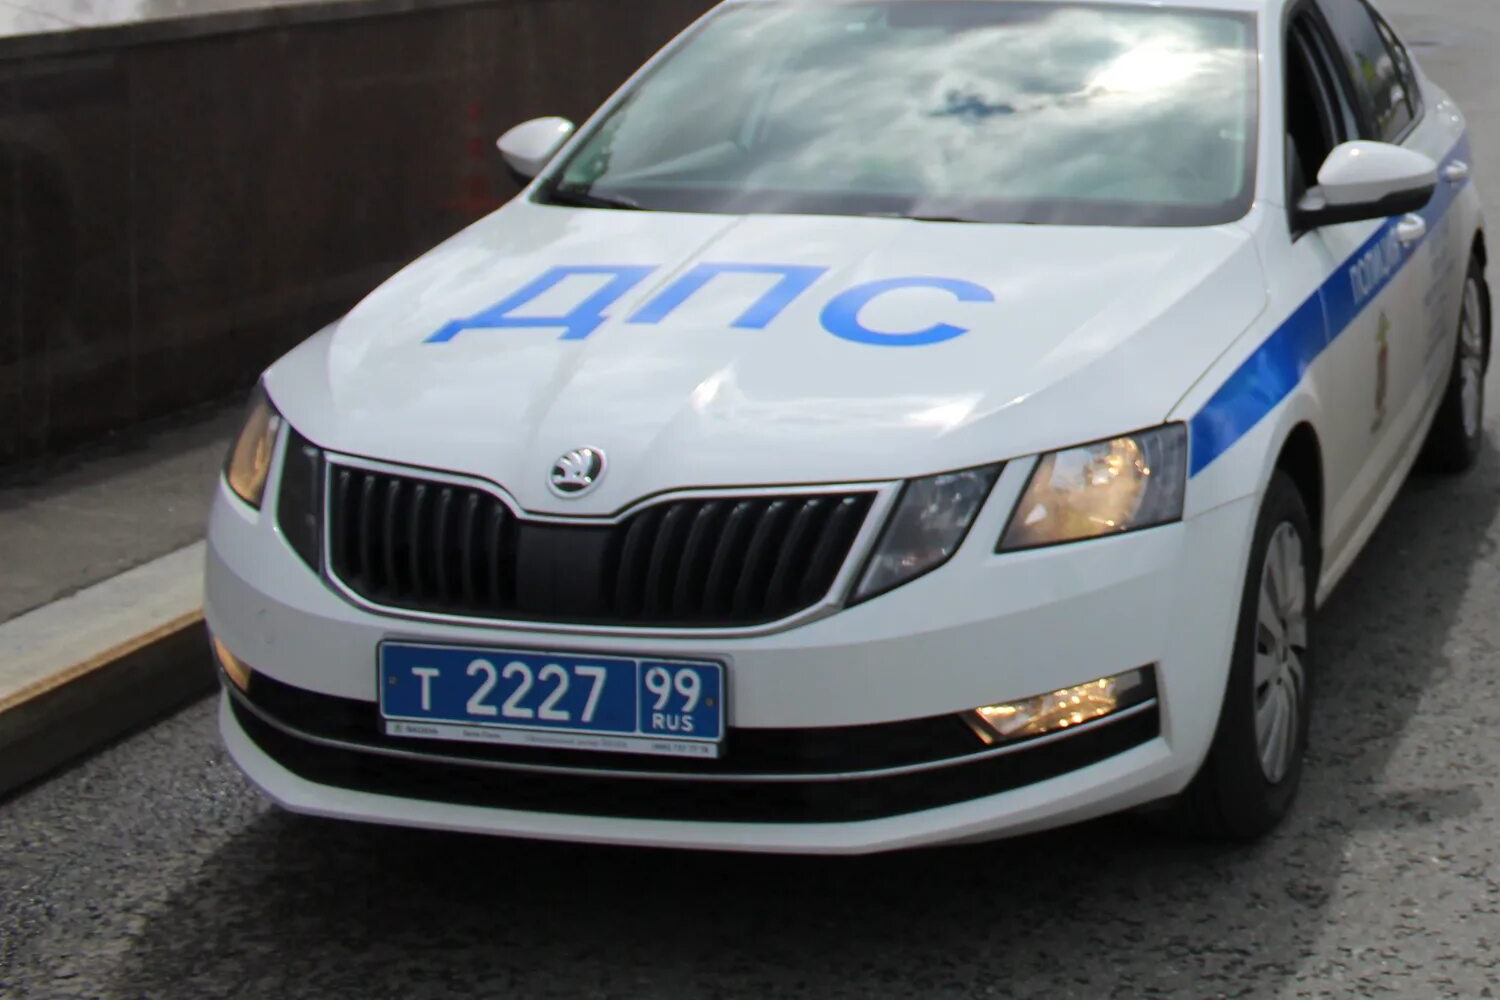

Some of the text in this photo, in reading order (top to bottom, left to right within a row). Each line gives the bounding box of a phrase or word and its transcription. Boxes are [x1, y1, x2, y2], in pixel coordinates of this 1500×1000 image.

[423, 264, 995, 346] ДПС
[411, 659, 702, 723] Т 2227 99
[652, 712, 694, 732] RUS
